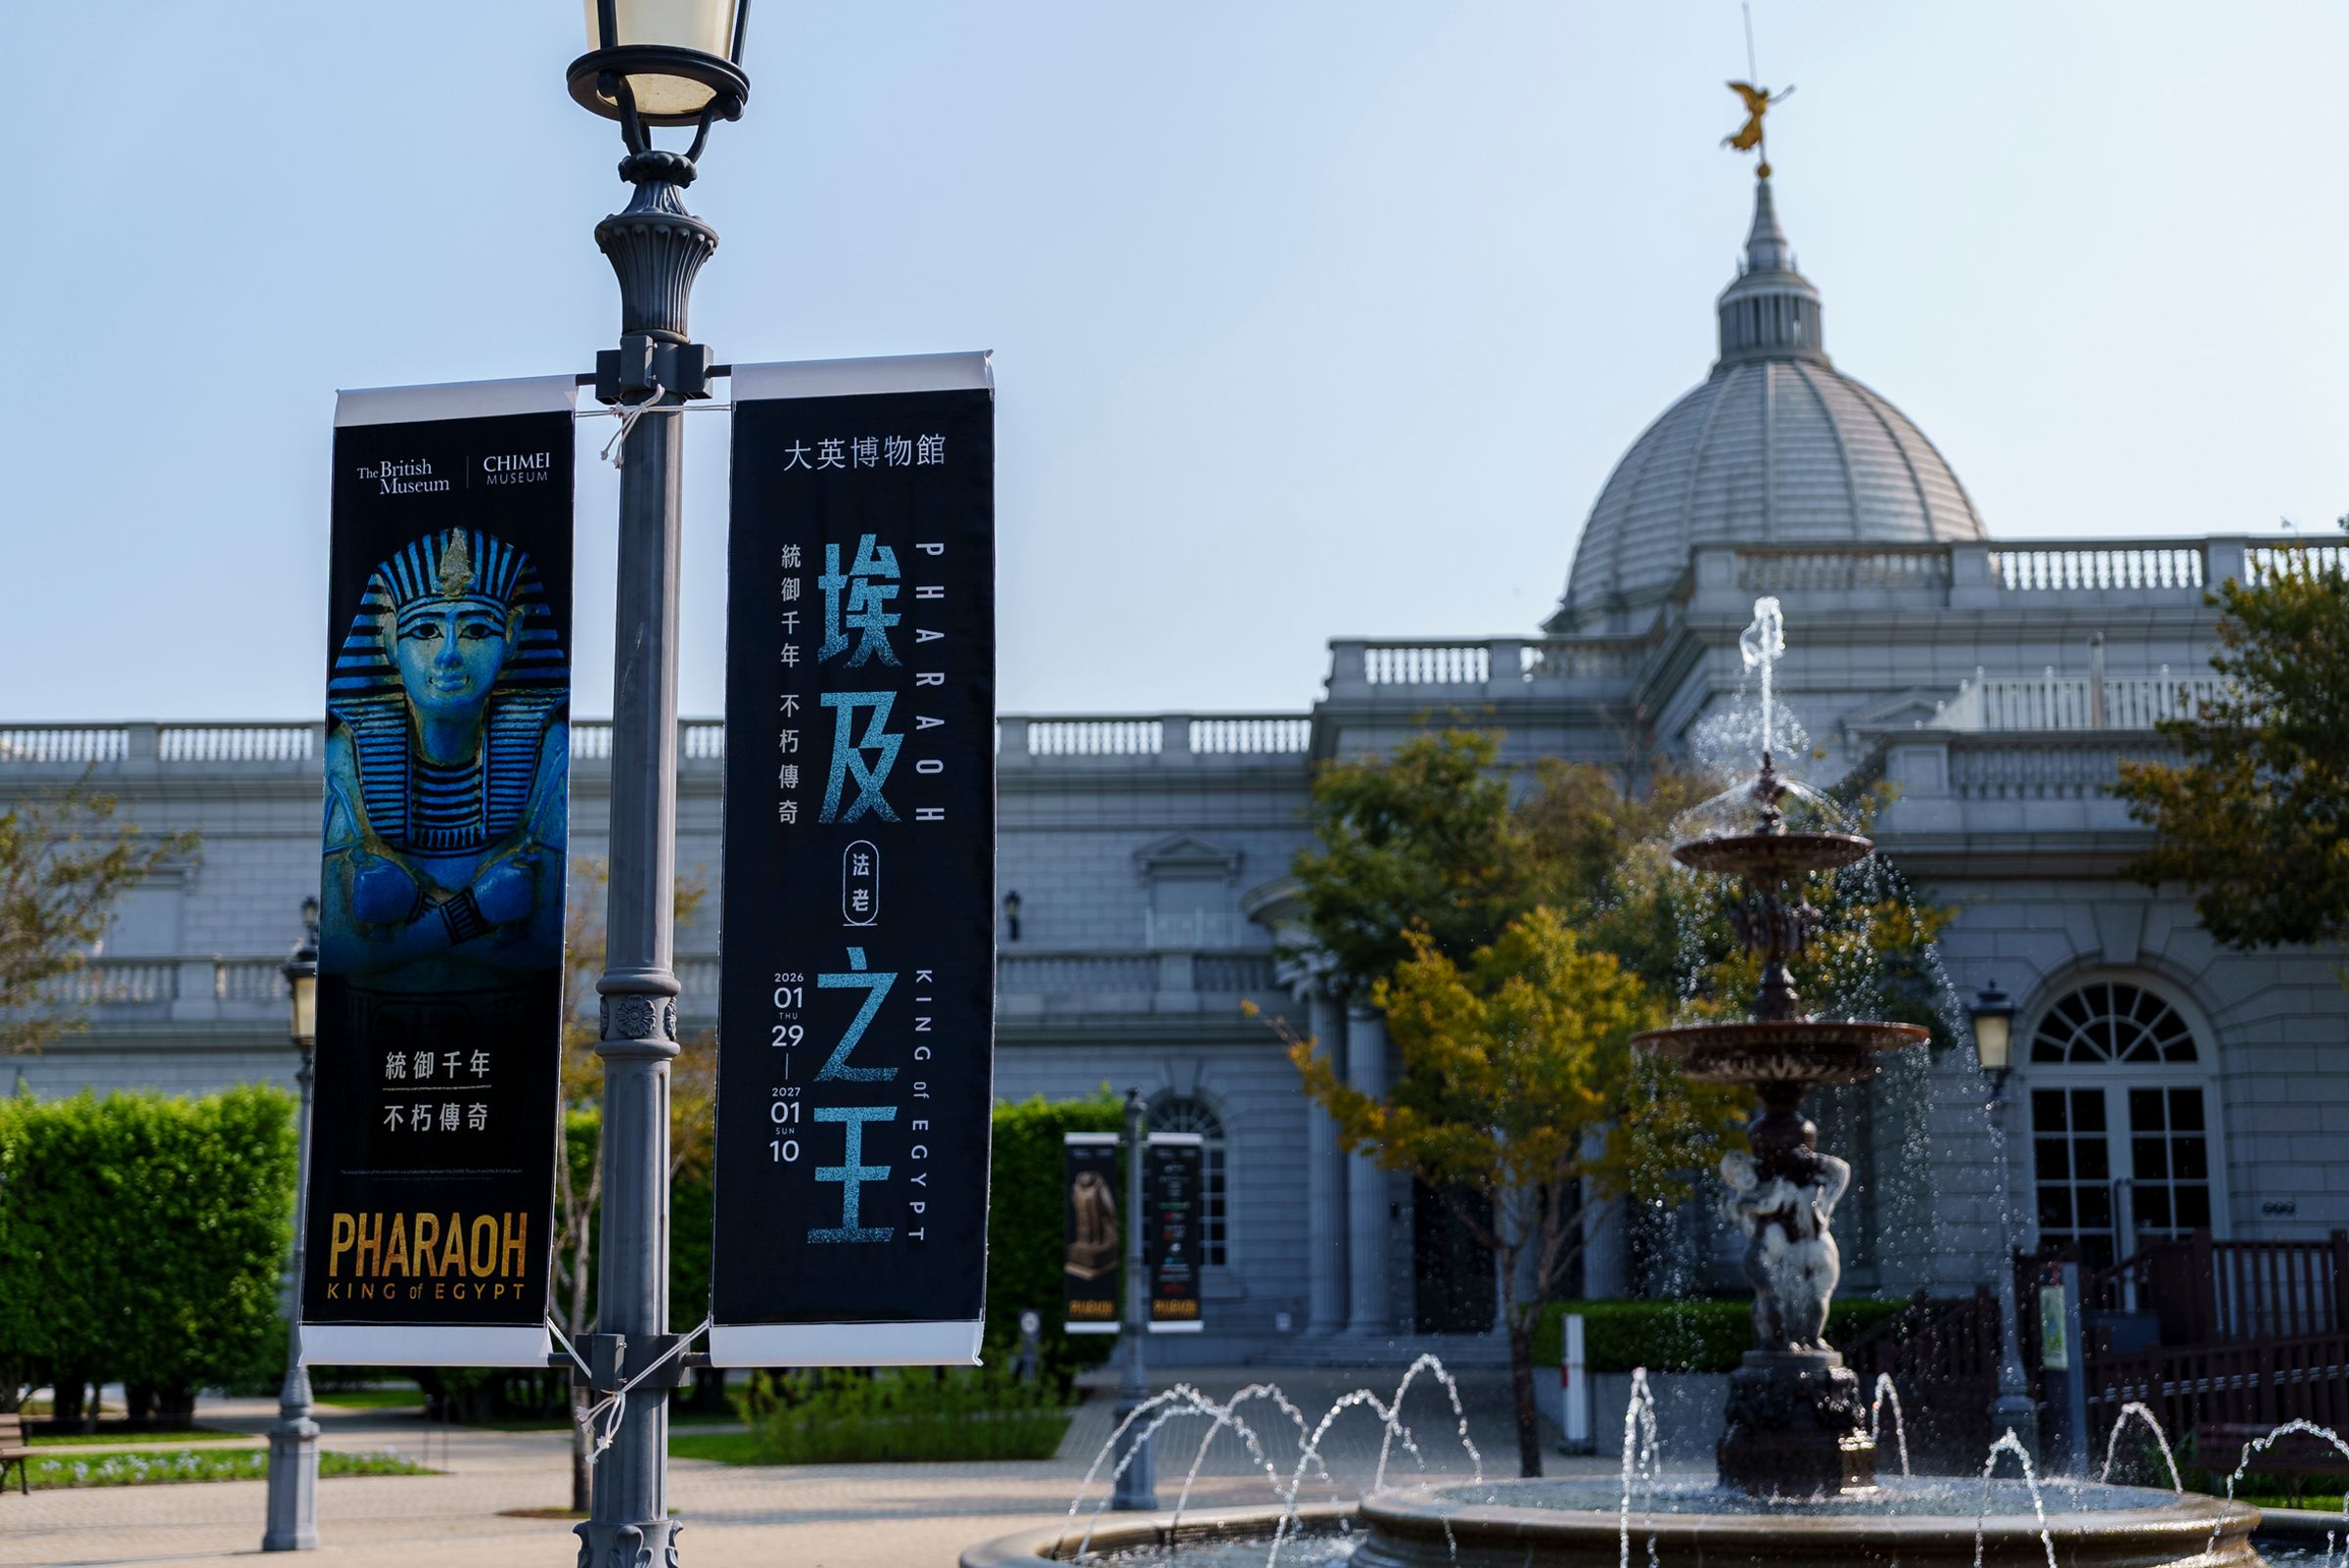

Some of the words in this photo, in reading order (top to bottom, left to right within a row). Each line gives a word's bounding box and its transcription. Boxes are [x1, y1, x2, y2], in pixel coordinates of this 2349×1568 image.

[483, 452, 551, 472] CHIMEI
[783, 433, 946, 471] 大英博物館
[356, 467, 379, 480] The
[380, 457, 433, 479] British
[486, 472, 549, 485] MUSEUM
[379, 478, 450, 495] Museum
[780, 544, 802, 669] 統御千年
[915, 542, 945, 821] PHARAOH
[778, 694, 800, 824] 不朽傳奇
[852, 853, 870, 911] 法老
[774, 973, 805, 983] 2026
[773, 987, 803, 1008] 01
[914, 970, 933, 1061] KING
[771, 1025, 805, 1046] 29
[385, 1048, 490, 1080] 統御千年
[771, 1087, 801, 1097] 2027
[913, 1082, 930, 1099] of
[383, 1102, 487, 1132] 不朽傳奇
[770, 1101, 800, 1123] 01
[769, 1140, 800, 1162] 10
[906, 1119, 929, 1241] EGYPT
[329, 1213, 528, 1277] PHARAOH
[327, 1283, 394, 1300] KING
[409, 1282, 424, 1300] of
[435, 1283, 525, 1300] EGYPT
